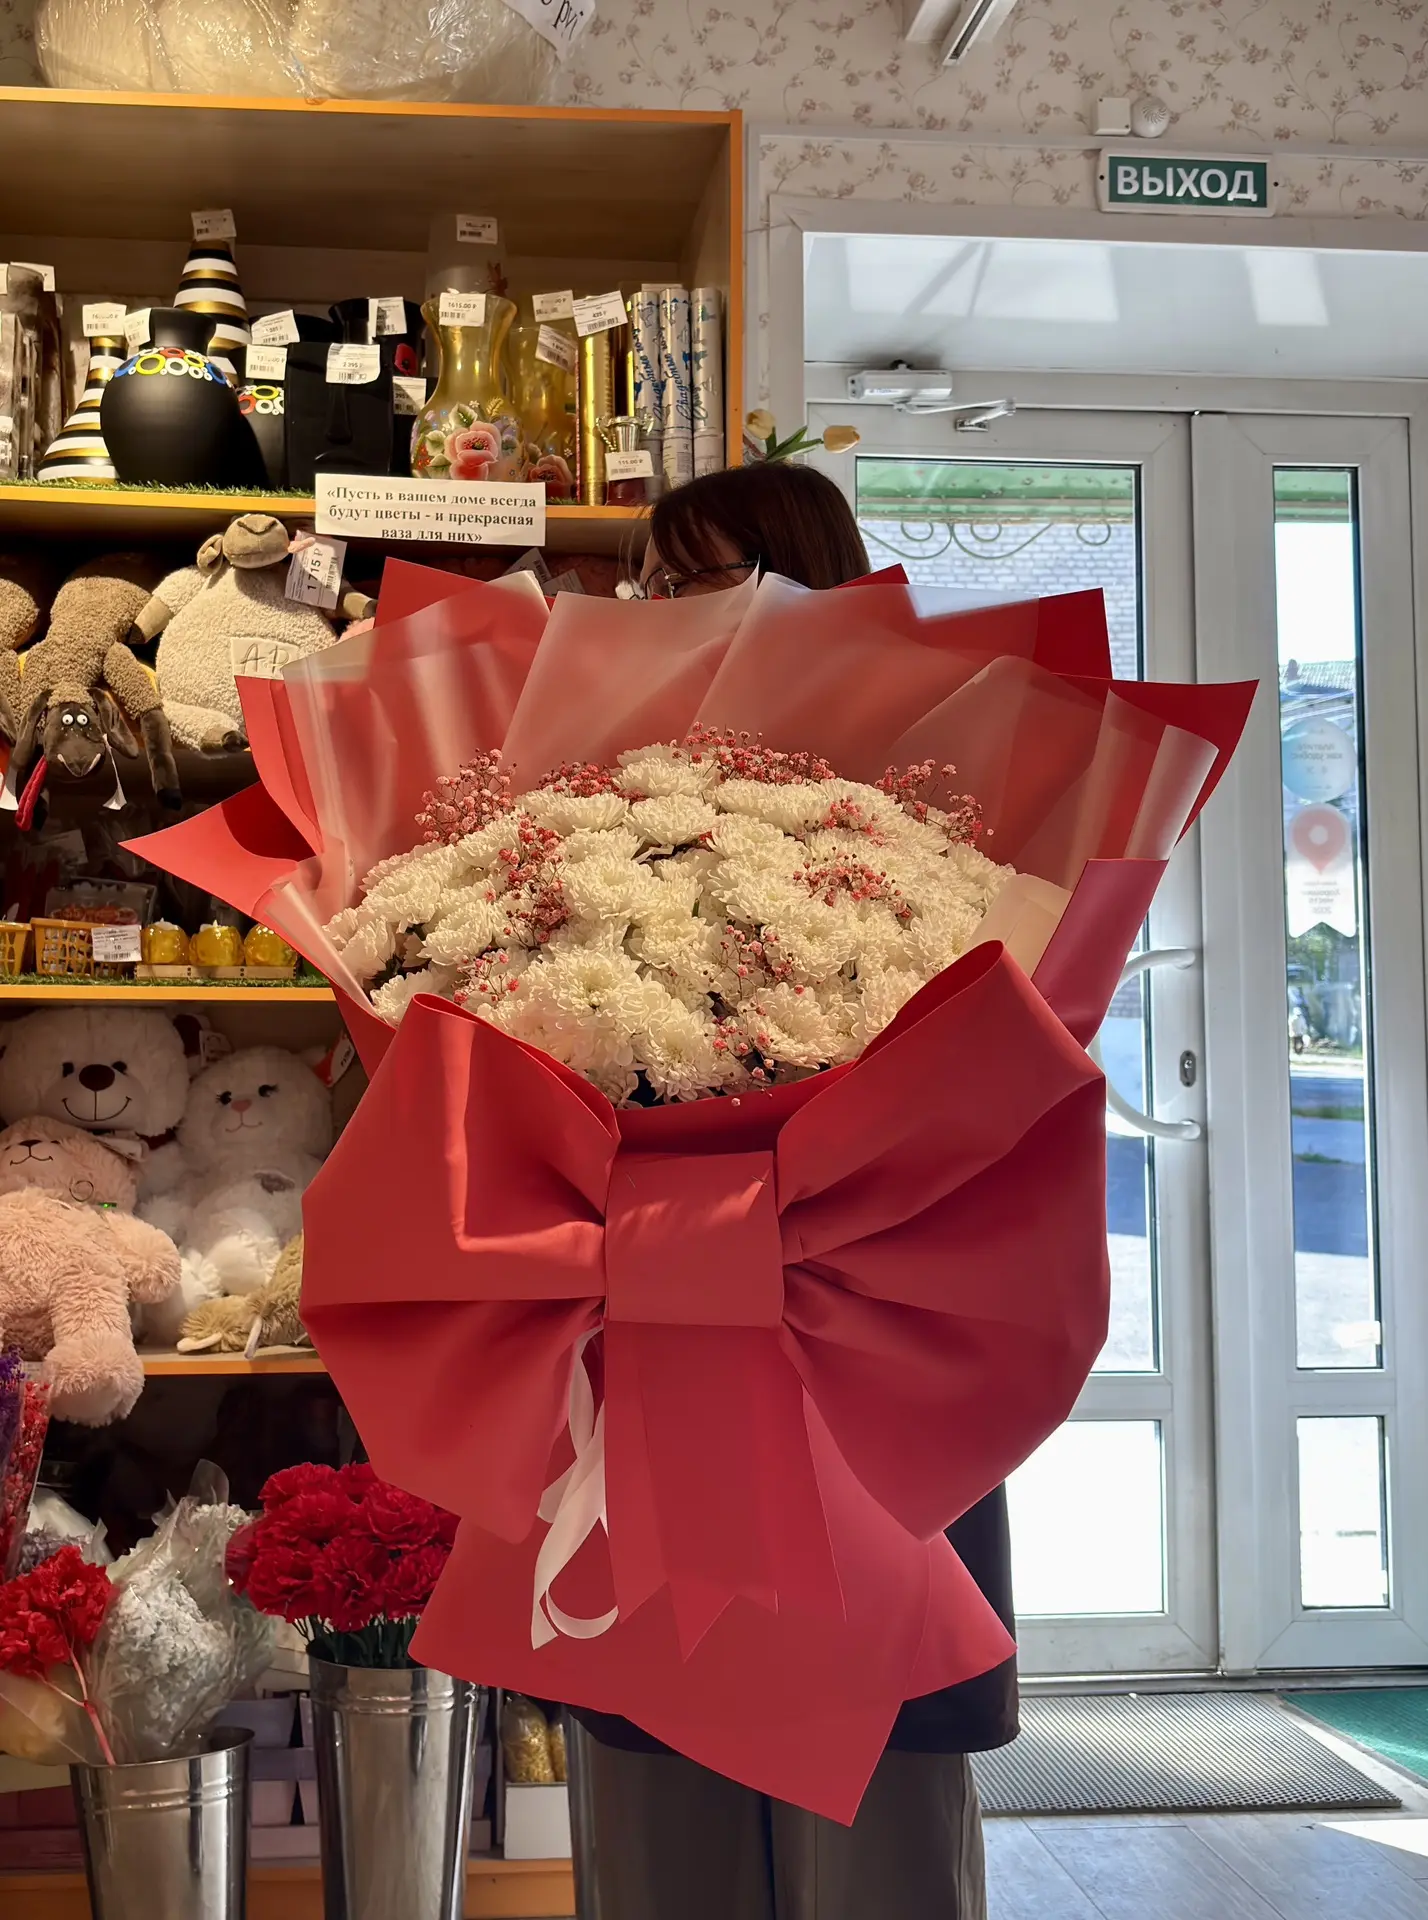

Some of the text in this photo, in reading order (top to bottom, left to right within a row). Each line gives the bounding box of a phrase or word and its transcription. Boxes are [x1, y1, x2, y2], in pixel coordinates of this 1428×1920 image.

[1117, 165, 1258, 202] ВЫХОД
[327, 486, 536, 508] «Пусть в вашем доме всегда
[329, 505, 370, 521] будут
[375, 510, 420, 521] цветы
[435, 512, 443, 522] и
[448, 513, 534, 527] прекрасная
[381, 528, 482, 542] ваза для них»
[308, 560, 321, 581] 715
